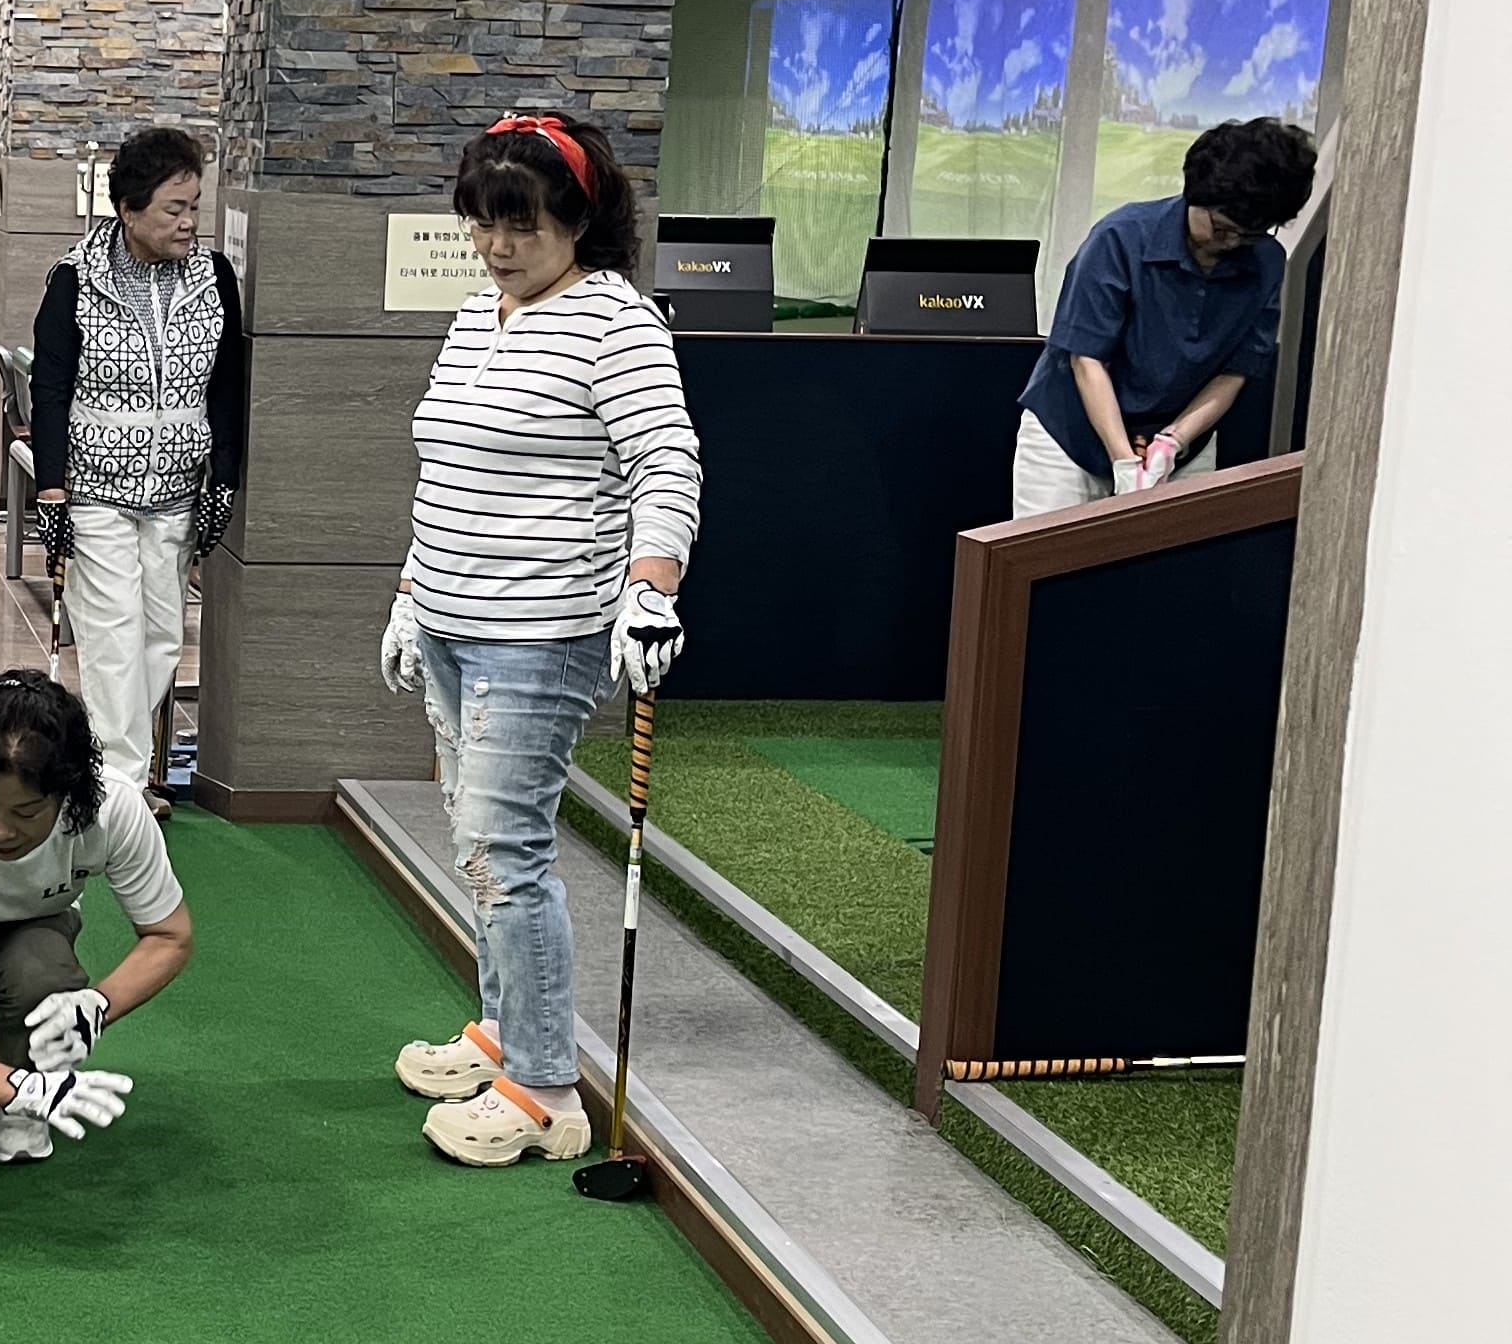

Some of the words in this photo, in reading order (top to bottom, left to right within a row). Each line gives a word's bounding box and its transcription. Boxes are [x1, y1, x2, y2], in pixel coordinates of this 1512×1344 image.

[400, 268, 417, 278] 타석
[677, 259, 731, 273] kakaoVX
[919, 293, 985, 309] kakaoVX
